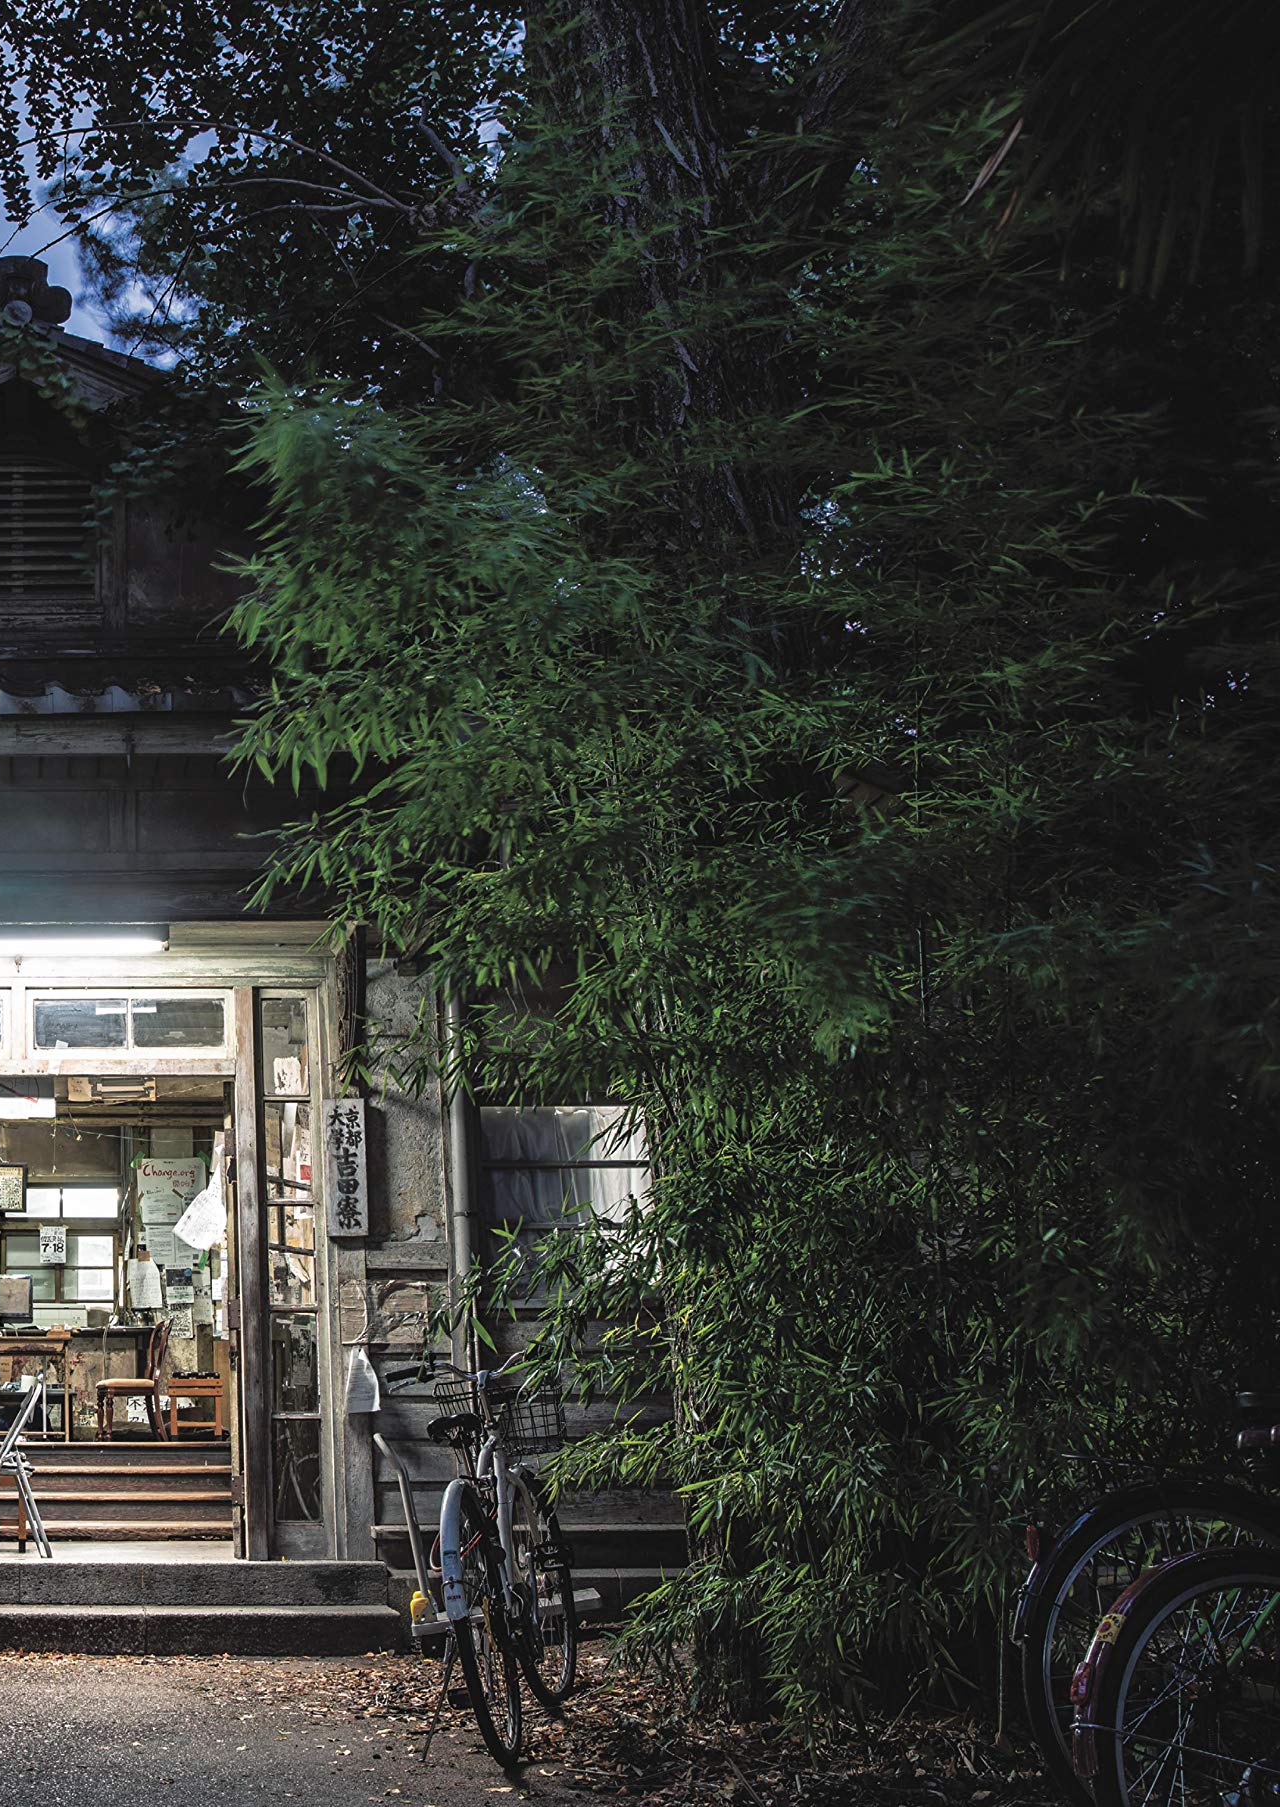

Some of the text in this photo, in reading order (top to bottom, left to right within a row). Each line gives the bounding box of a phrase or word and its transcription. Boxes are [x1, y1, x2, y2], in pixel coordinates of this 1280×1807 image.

[328, 1107, 346, 1151] 大学
[344, 1107, 363, 1149] 京都
[142, 1164, 195, 1180] Change.org
[333, 1147, 362, 1229] 吉田寮
